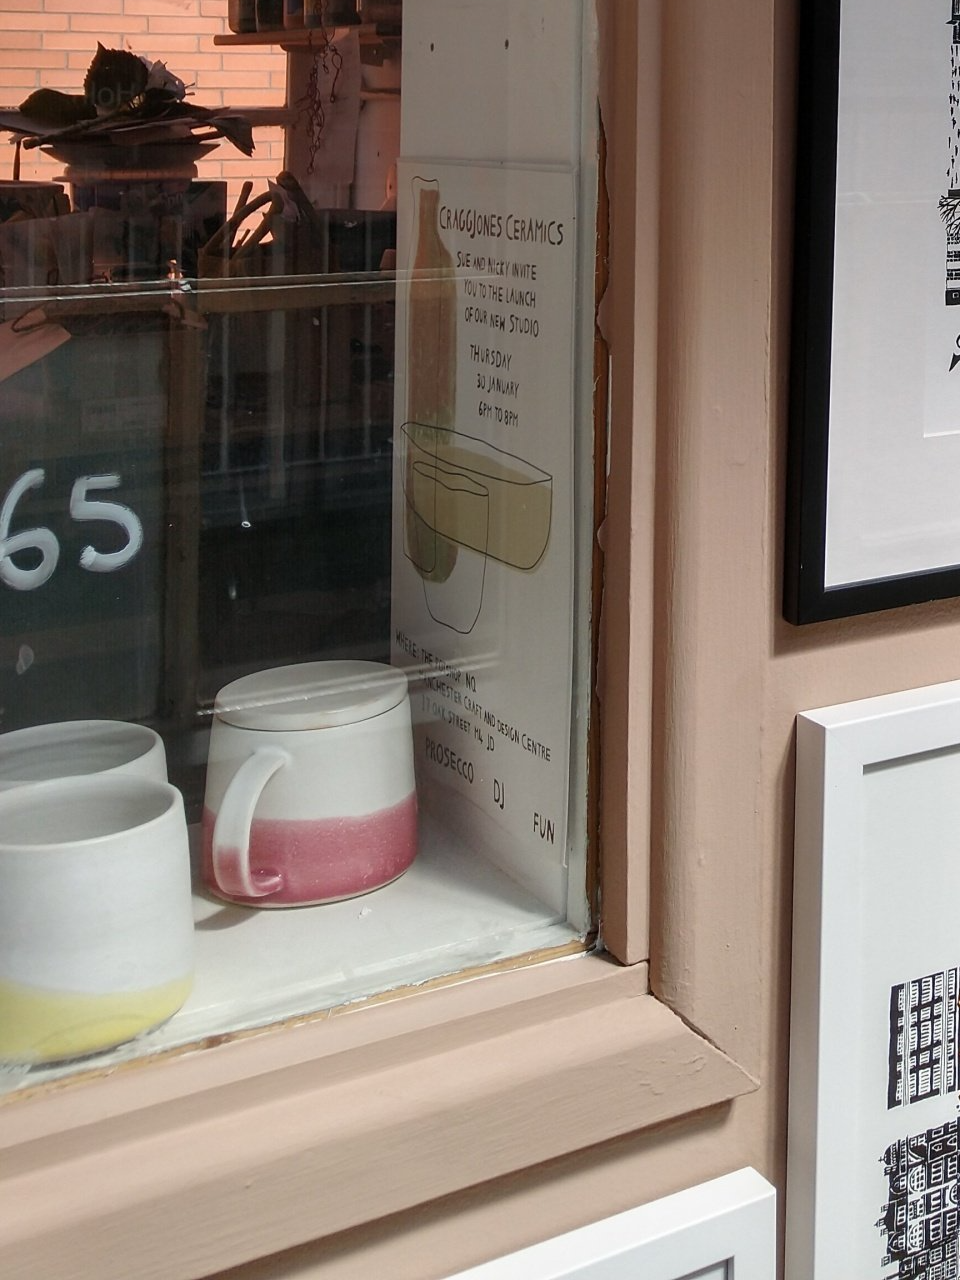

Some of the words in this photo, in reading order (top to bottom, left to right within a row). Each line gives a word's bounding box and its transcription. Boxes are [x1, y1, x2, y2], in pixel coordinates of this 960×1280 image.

[439, 205, 502, 239] CRAGGJONES
[506, 214, 564, 245] CERAMICS
[457, 251, 471, 268] SUE
[473, 257, 486, 271] AND
[488, 256, 511, 278] NICKY
[512, 262, 537, 281] INVITE
[464, 279, 478, 297] YOU
[479, 283, 487, 299] TO
[488, 285, 503, 303] THE
[506, 287, 537, 308] LAUNCH
[465, 306, 474, 322] OF
[474, 308, 488, 325] OUR
[490, 312, 506, 332] NEW
[509, 314, 539, 338] STUDIO
[470, 344, 513, 371] THURSDAY
[477, 373, 486, 389] 30
[487, 375, 520, 399] JANUARY
[478, 401, 492, 418] 6PM
[495, 405, 503, 421] TO
[504, 409, 519, 428] 8PM
[448, 710, 471, 734] STREET
[464, 696, 482, 719] CRAFT
[484, 710, 496, 728] AND
[497, 720, 520, 745] DESIGN
[521, 733, 551, 762] CENTRE
[425, 736, 474, 784] PROSECCO
[493, 779, 505, 810] DJ
[533, 812, 555, 845] FUN
